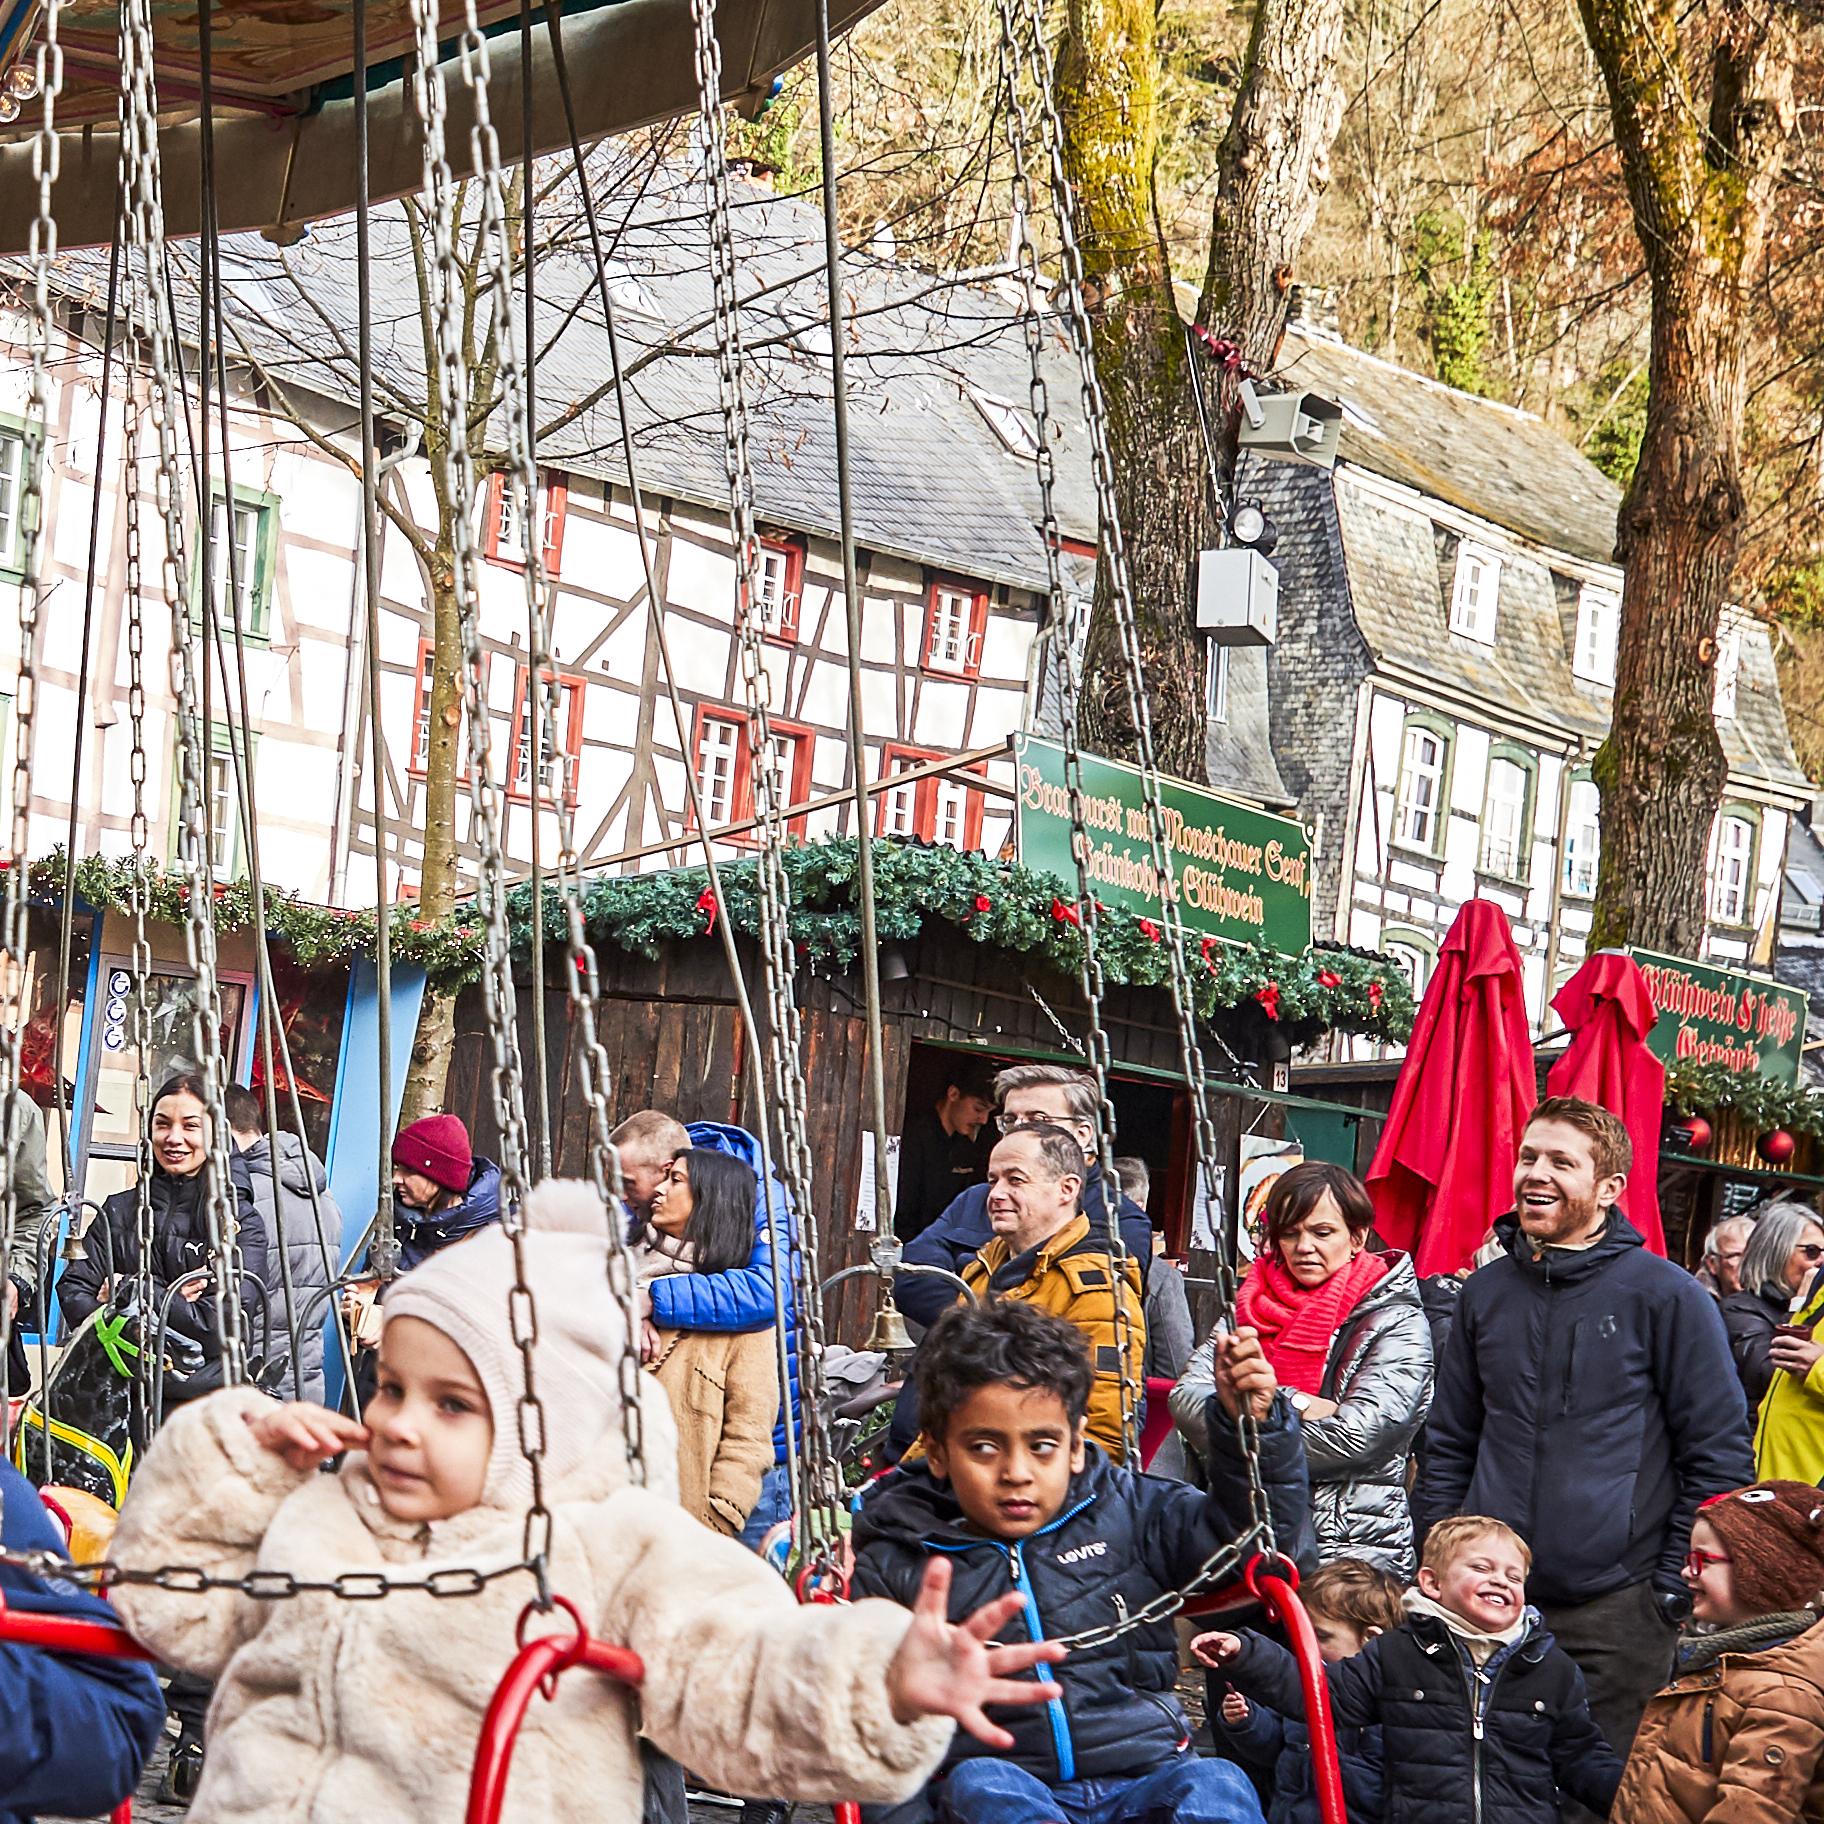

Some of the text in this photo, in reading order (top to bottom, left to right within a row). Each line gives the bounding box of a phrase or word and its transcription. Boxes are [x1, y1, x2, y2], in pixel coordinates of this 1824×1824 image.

[1126, 803, 1162, 845] mi
[1183, 864, 1265, 926] Glühwein
[1640, 963, 1736, 1028] Glühwein
[1736, 987, 1757, 1034] &
[1275, 1070, 1287, 1088] 13
